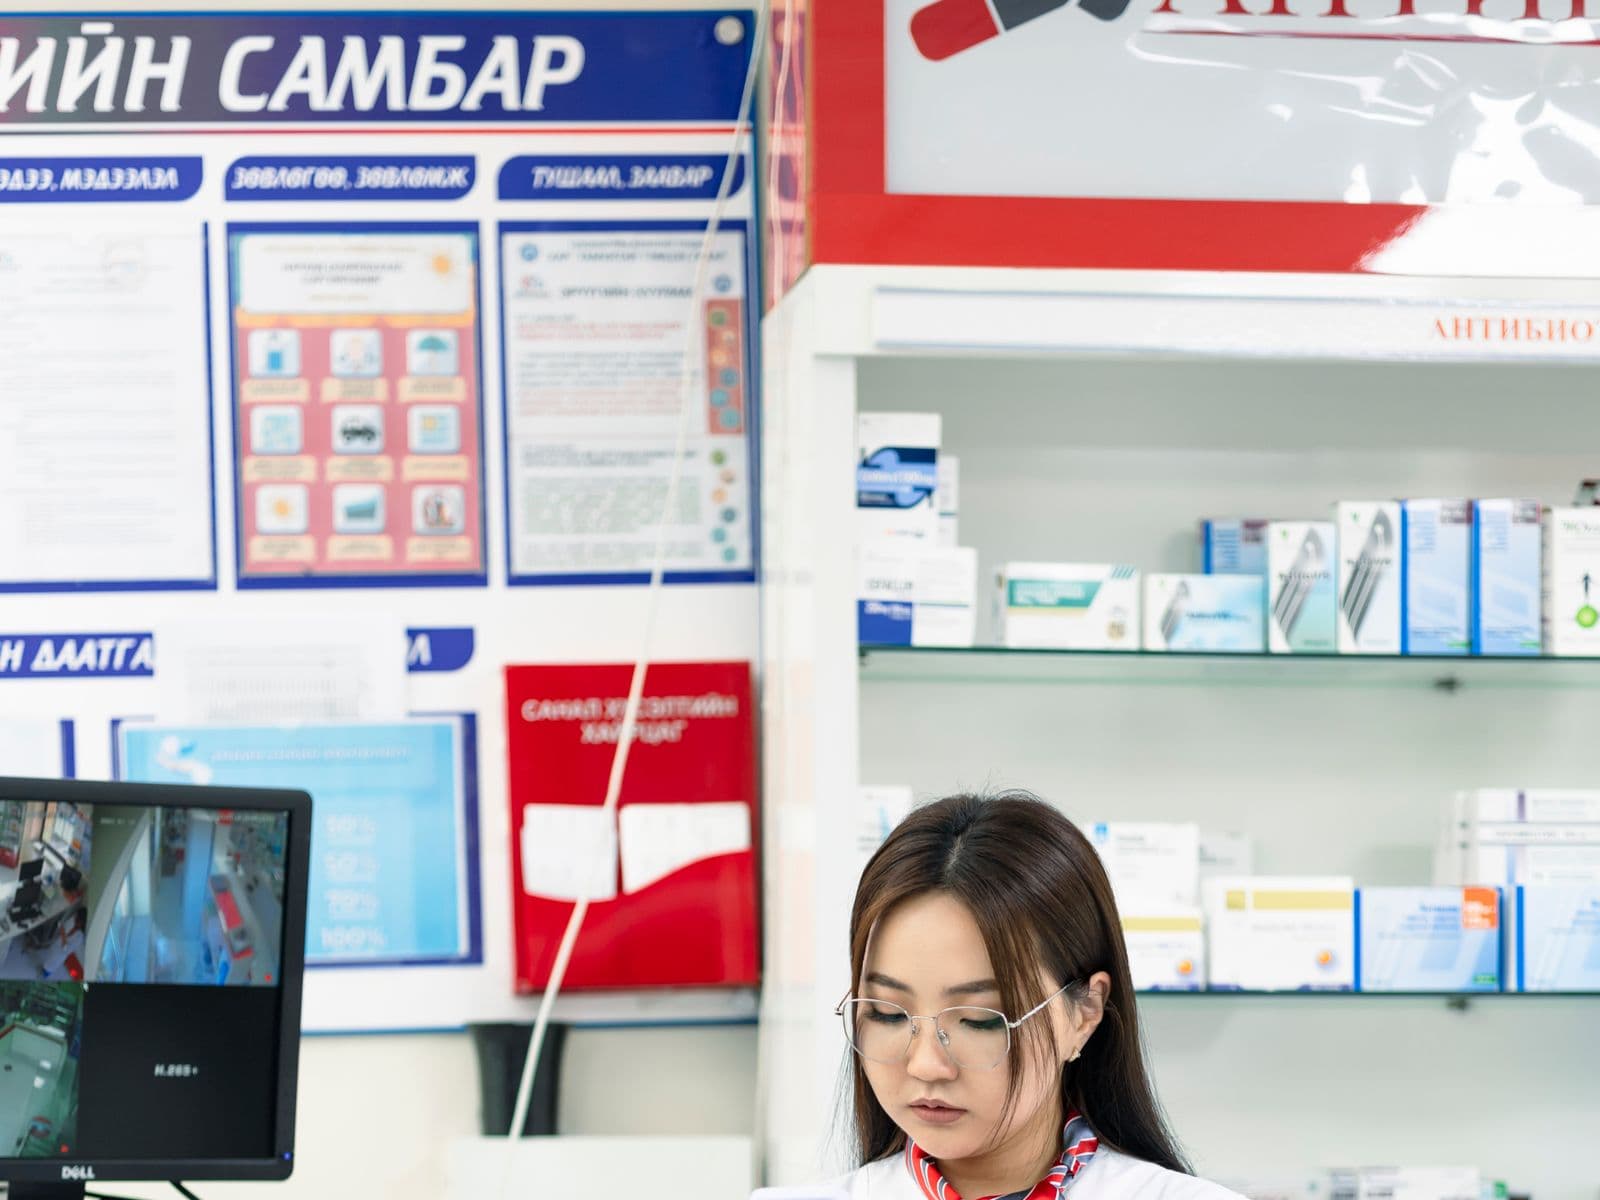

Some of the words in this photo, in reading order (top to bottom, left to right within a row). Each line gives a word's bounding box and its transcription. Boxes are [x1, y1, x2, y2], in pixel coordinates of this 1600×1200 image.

[0, 22, 192, 112] ИЙН
[218, 35, 585, 112] САМБАР
[1430, 316, 1600, 341] АНТИБИО
[61, 1164, 95, 1180] DELL
